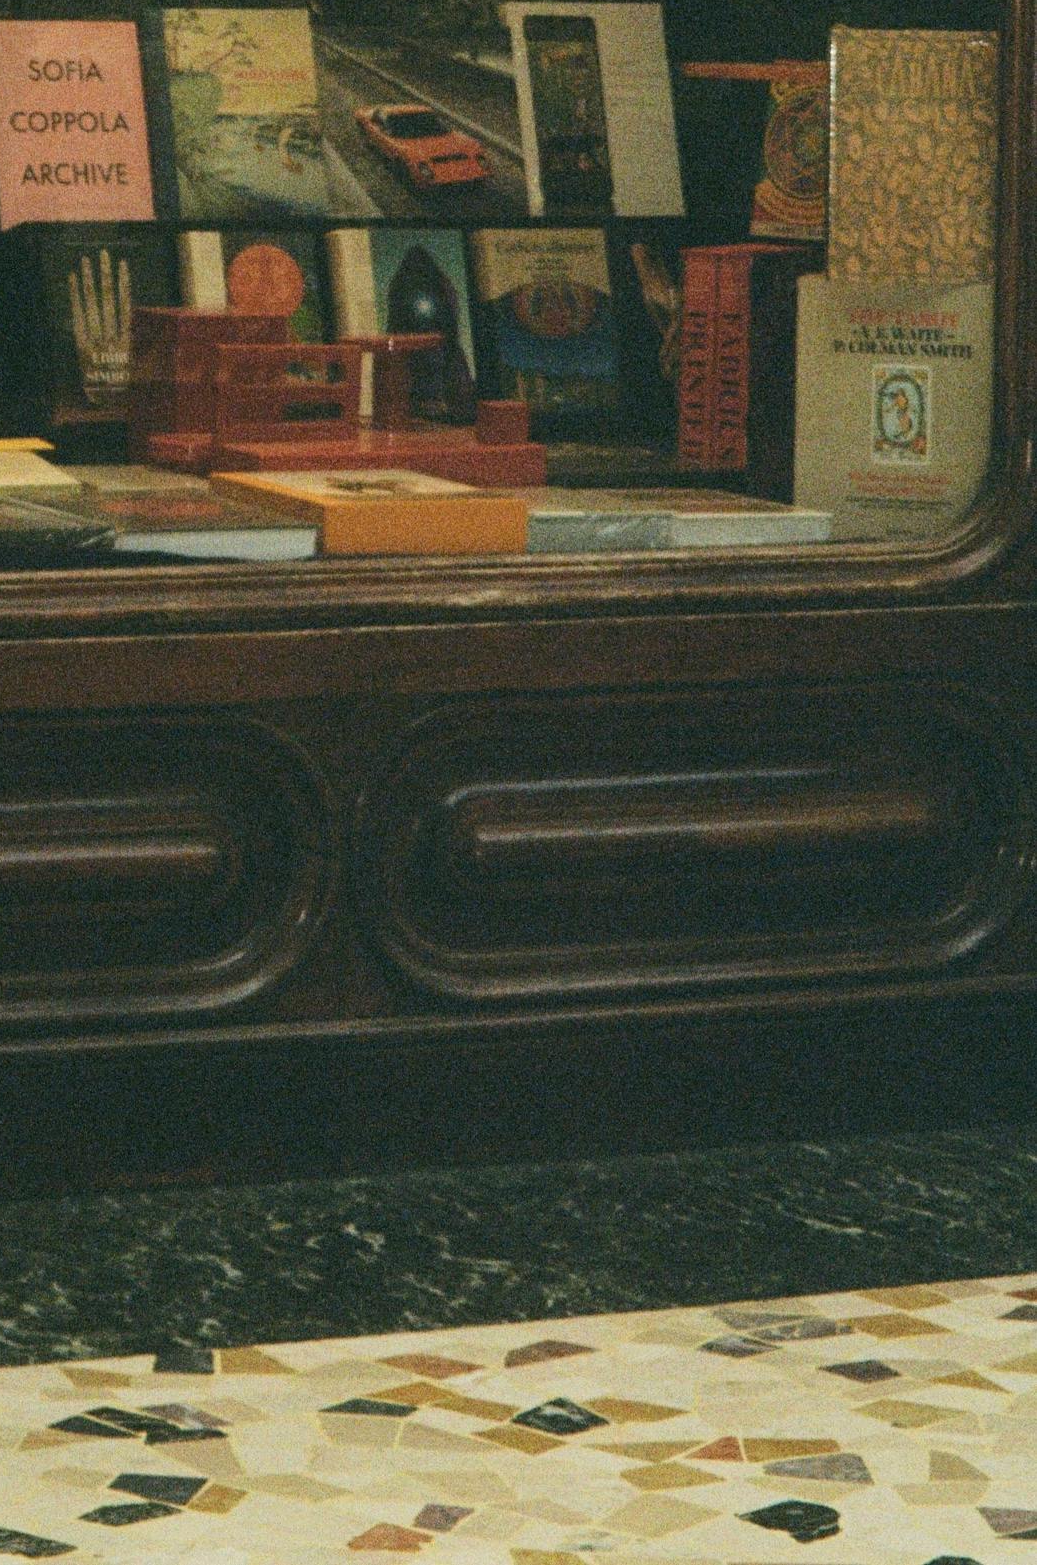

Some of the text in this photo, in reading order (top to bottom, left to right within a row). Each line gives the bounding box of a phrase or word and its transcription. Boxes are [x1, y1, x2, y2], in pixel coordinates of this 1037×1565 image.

[28, 58, 102, 84] SOFIA
[9, 109, 130, 135] COPPOLA
[20, 161, 129, 188] ARCHIVE
